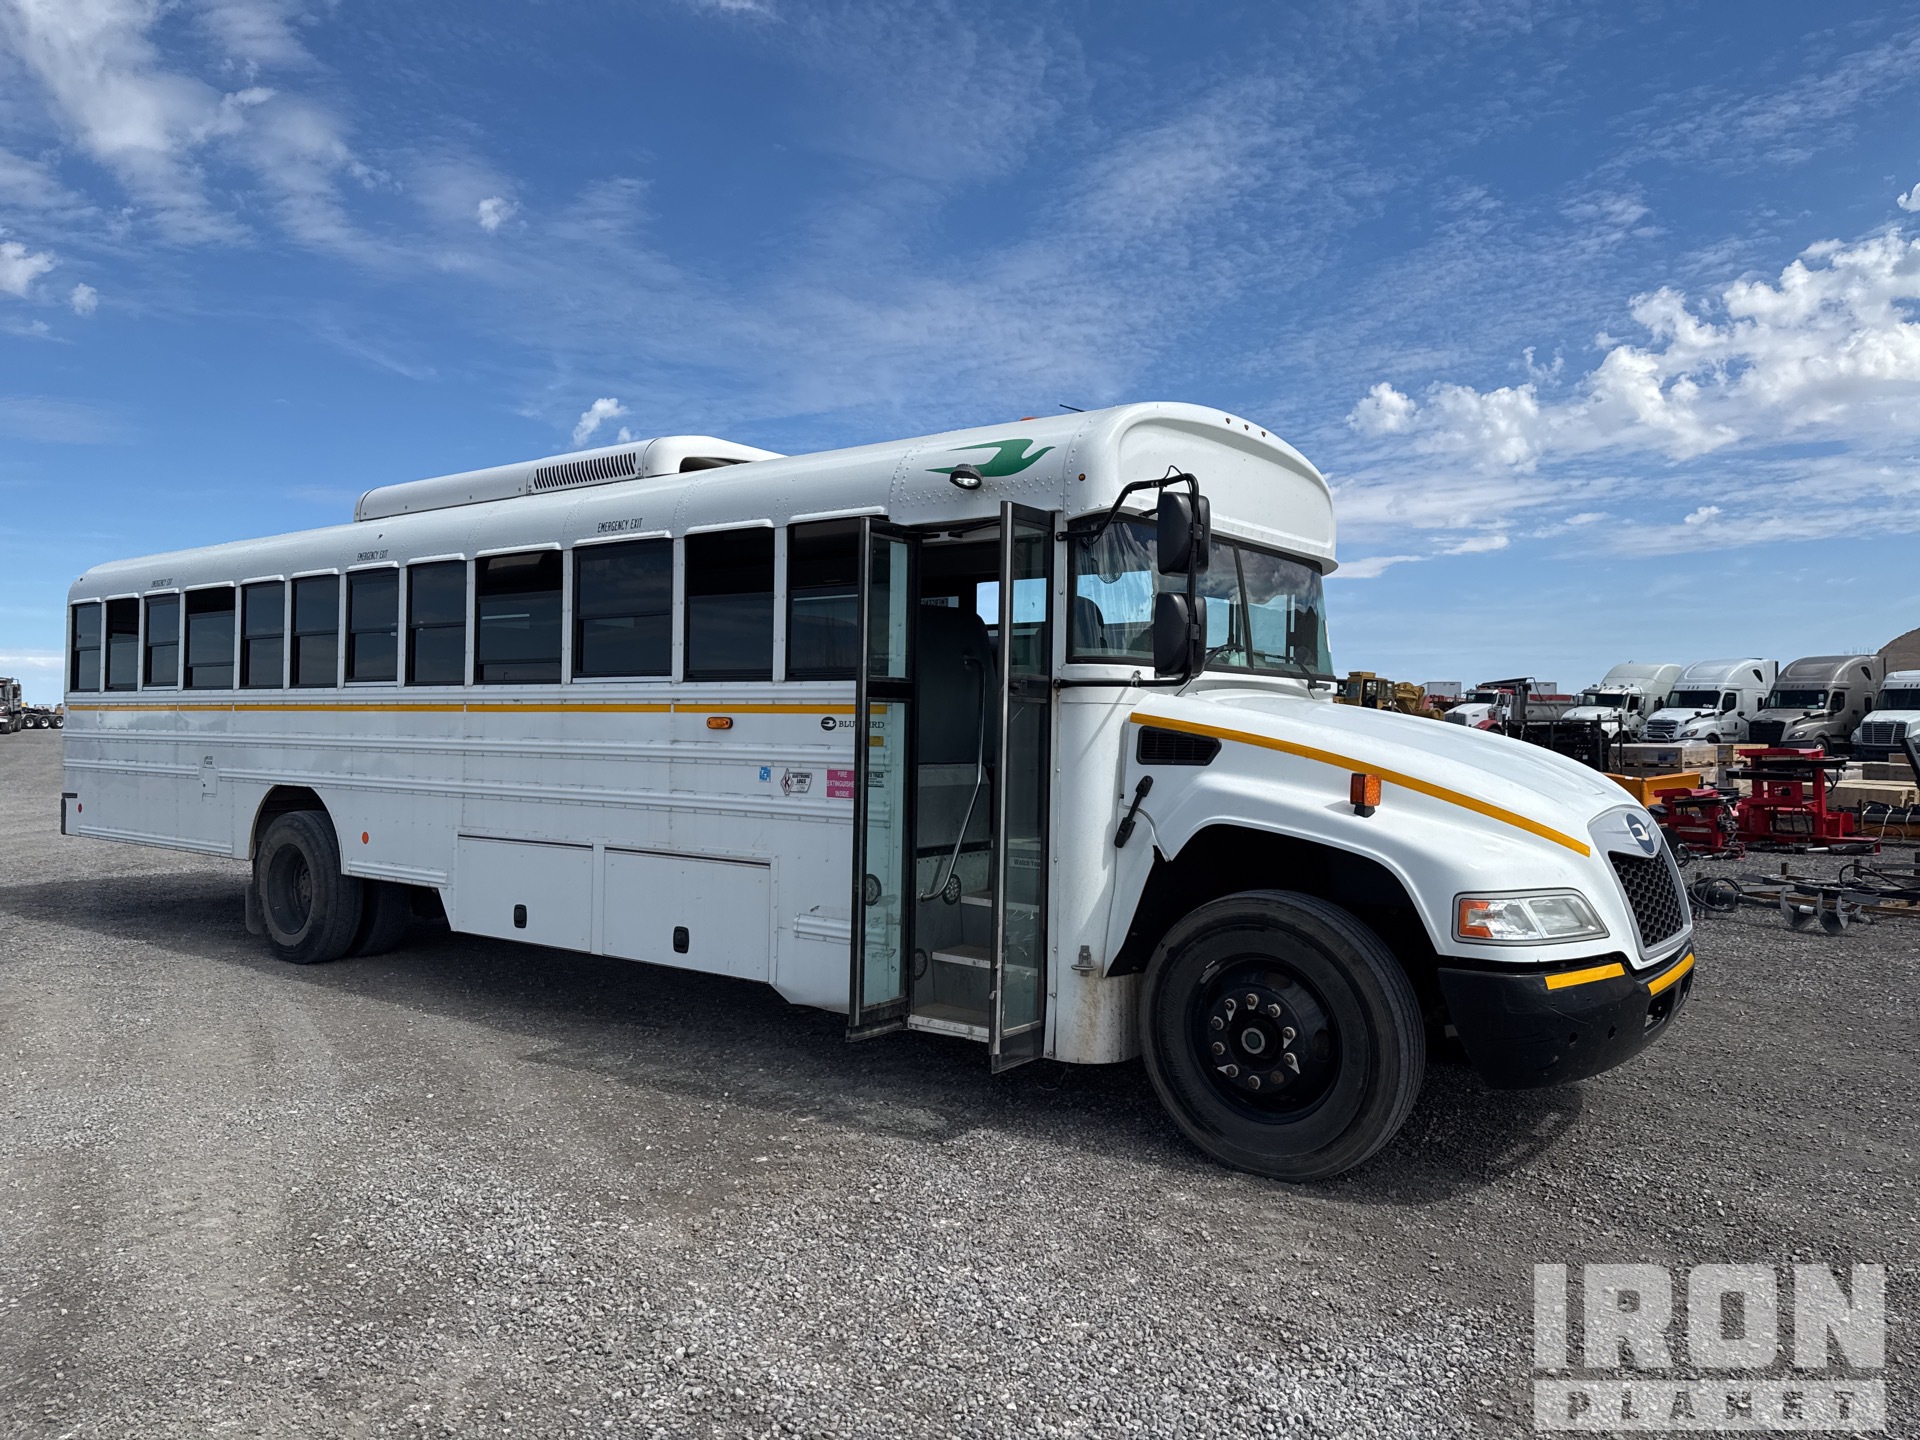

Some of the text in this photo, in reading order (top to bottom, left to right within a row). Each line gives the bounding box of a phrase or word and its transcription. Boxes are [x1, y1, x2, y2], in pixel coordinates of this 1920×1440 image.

[597, 517, 643, 533] EMERGENCY EXIT
[838, 720, 885, 729] BLU IRD
[837, 770, 848, 778] FIRE
[784, 776, 790, 788] K
[827, 779, 855, 788] EXTINGUISHE
[835, 790, 849, 798] INSIDE
